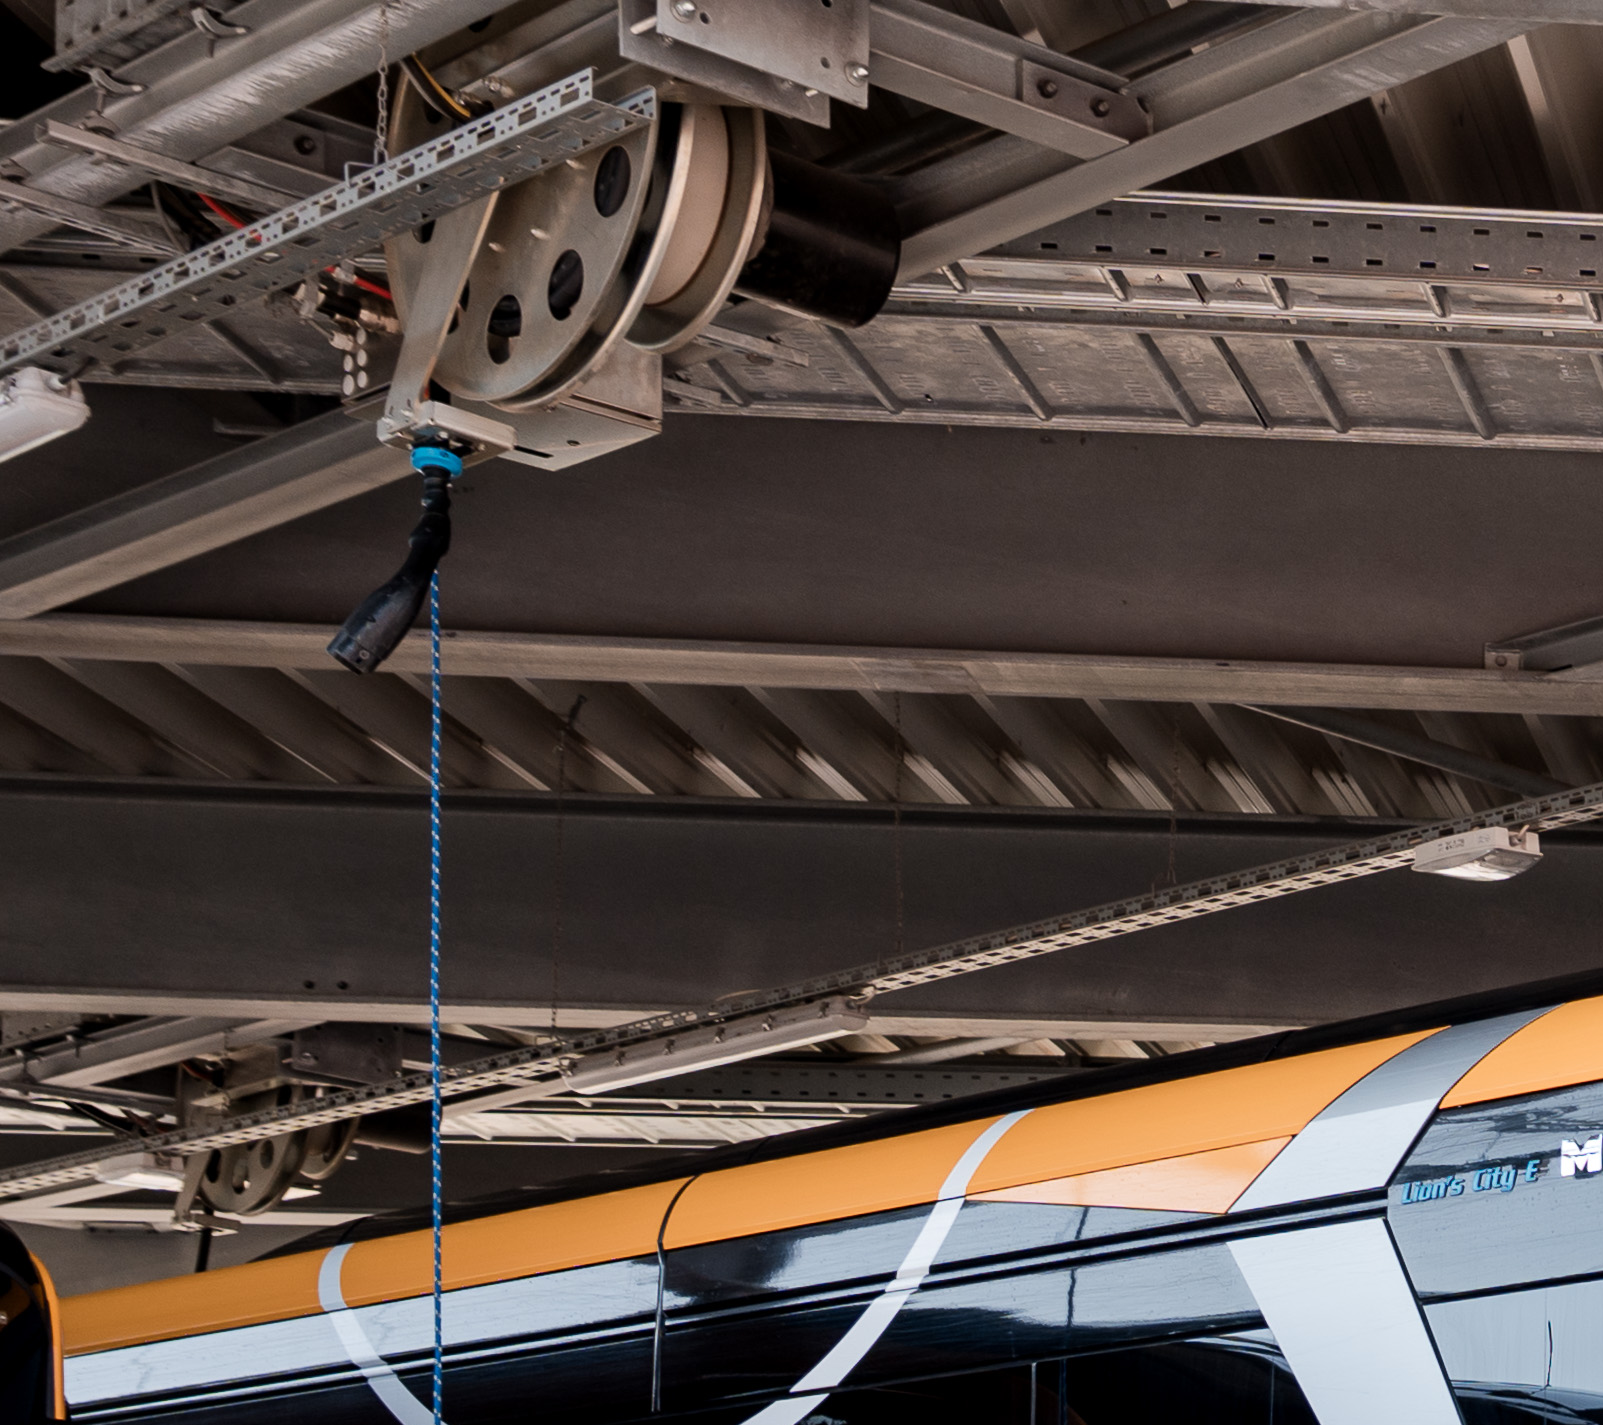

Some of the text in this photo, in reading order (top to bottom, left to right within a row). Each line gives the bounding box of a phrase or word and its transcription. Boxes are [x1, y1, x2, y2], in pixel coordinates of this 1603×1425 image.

[1401, 1159, 1541, 1204] Lion's City E
